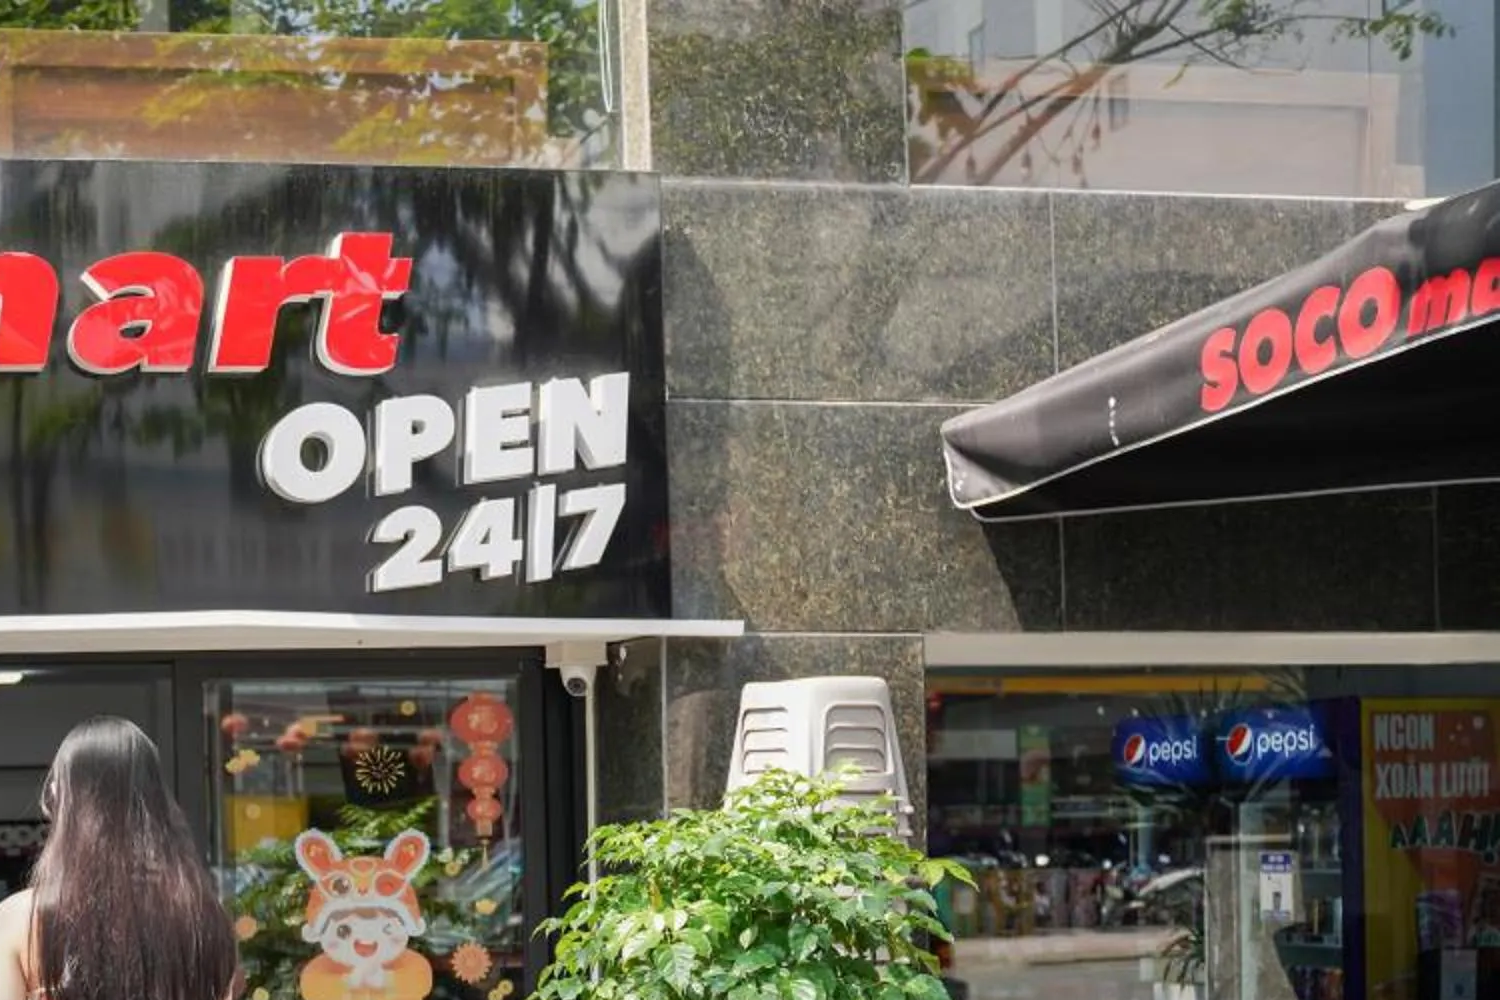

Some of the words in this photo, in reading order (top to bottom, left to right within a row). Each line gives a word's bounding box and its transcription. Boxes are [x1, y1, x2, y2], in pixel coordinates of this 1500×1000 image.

[1201, 266, 1399, 412] SOCO
[257, 371, 630, 503] OPEN
[1149, 735, 1197, 766] pepsi
[1257, 724, 1316, 760] pepsi
